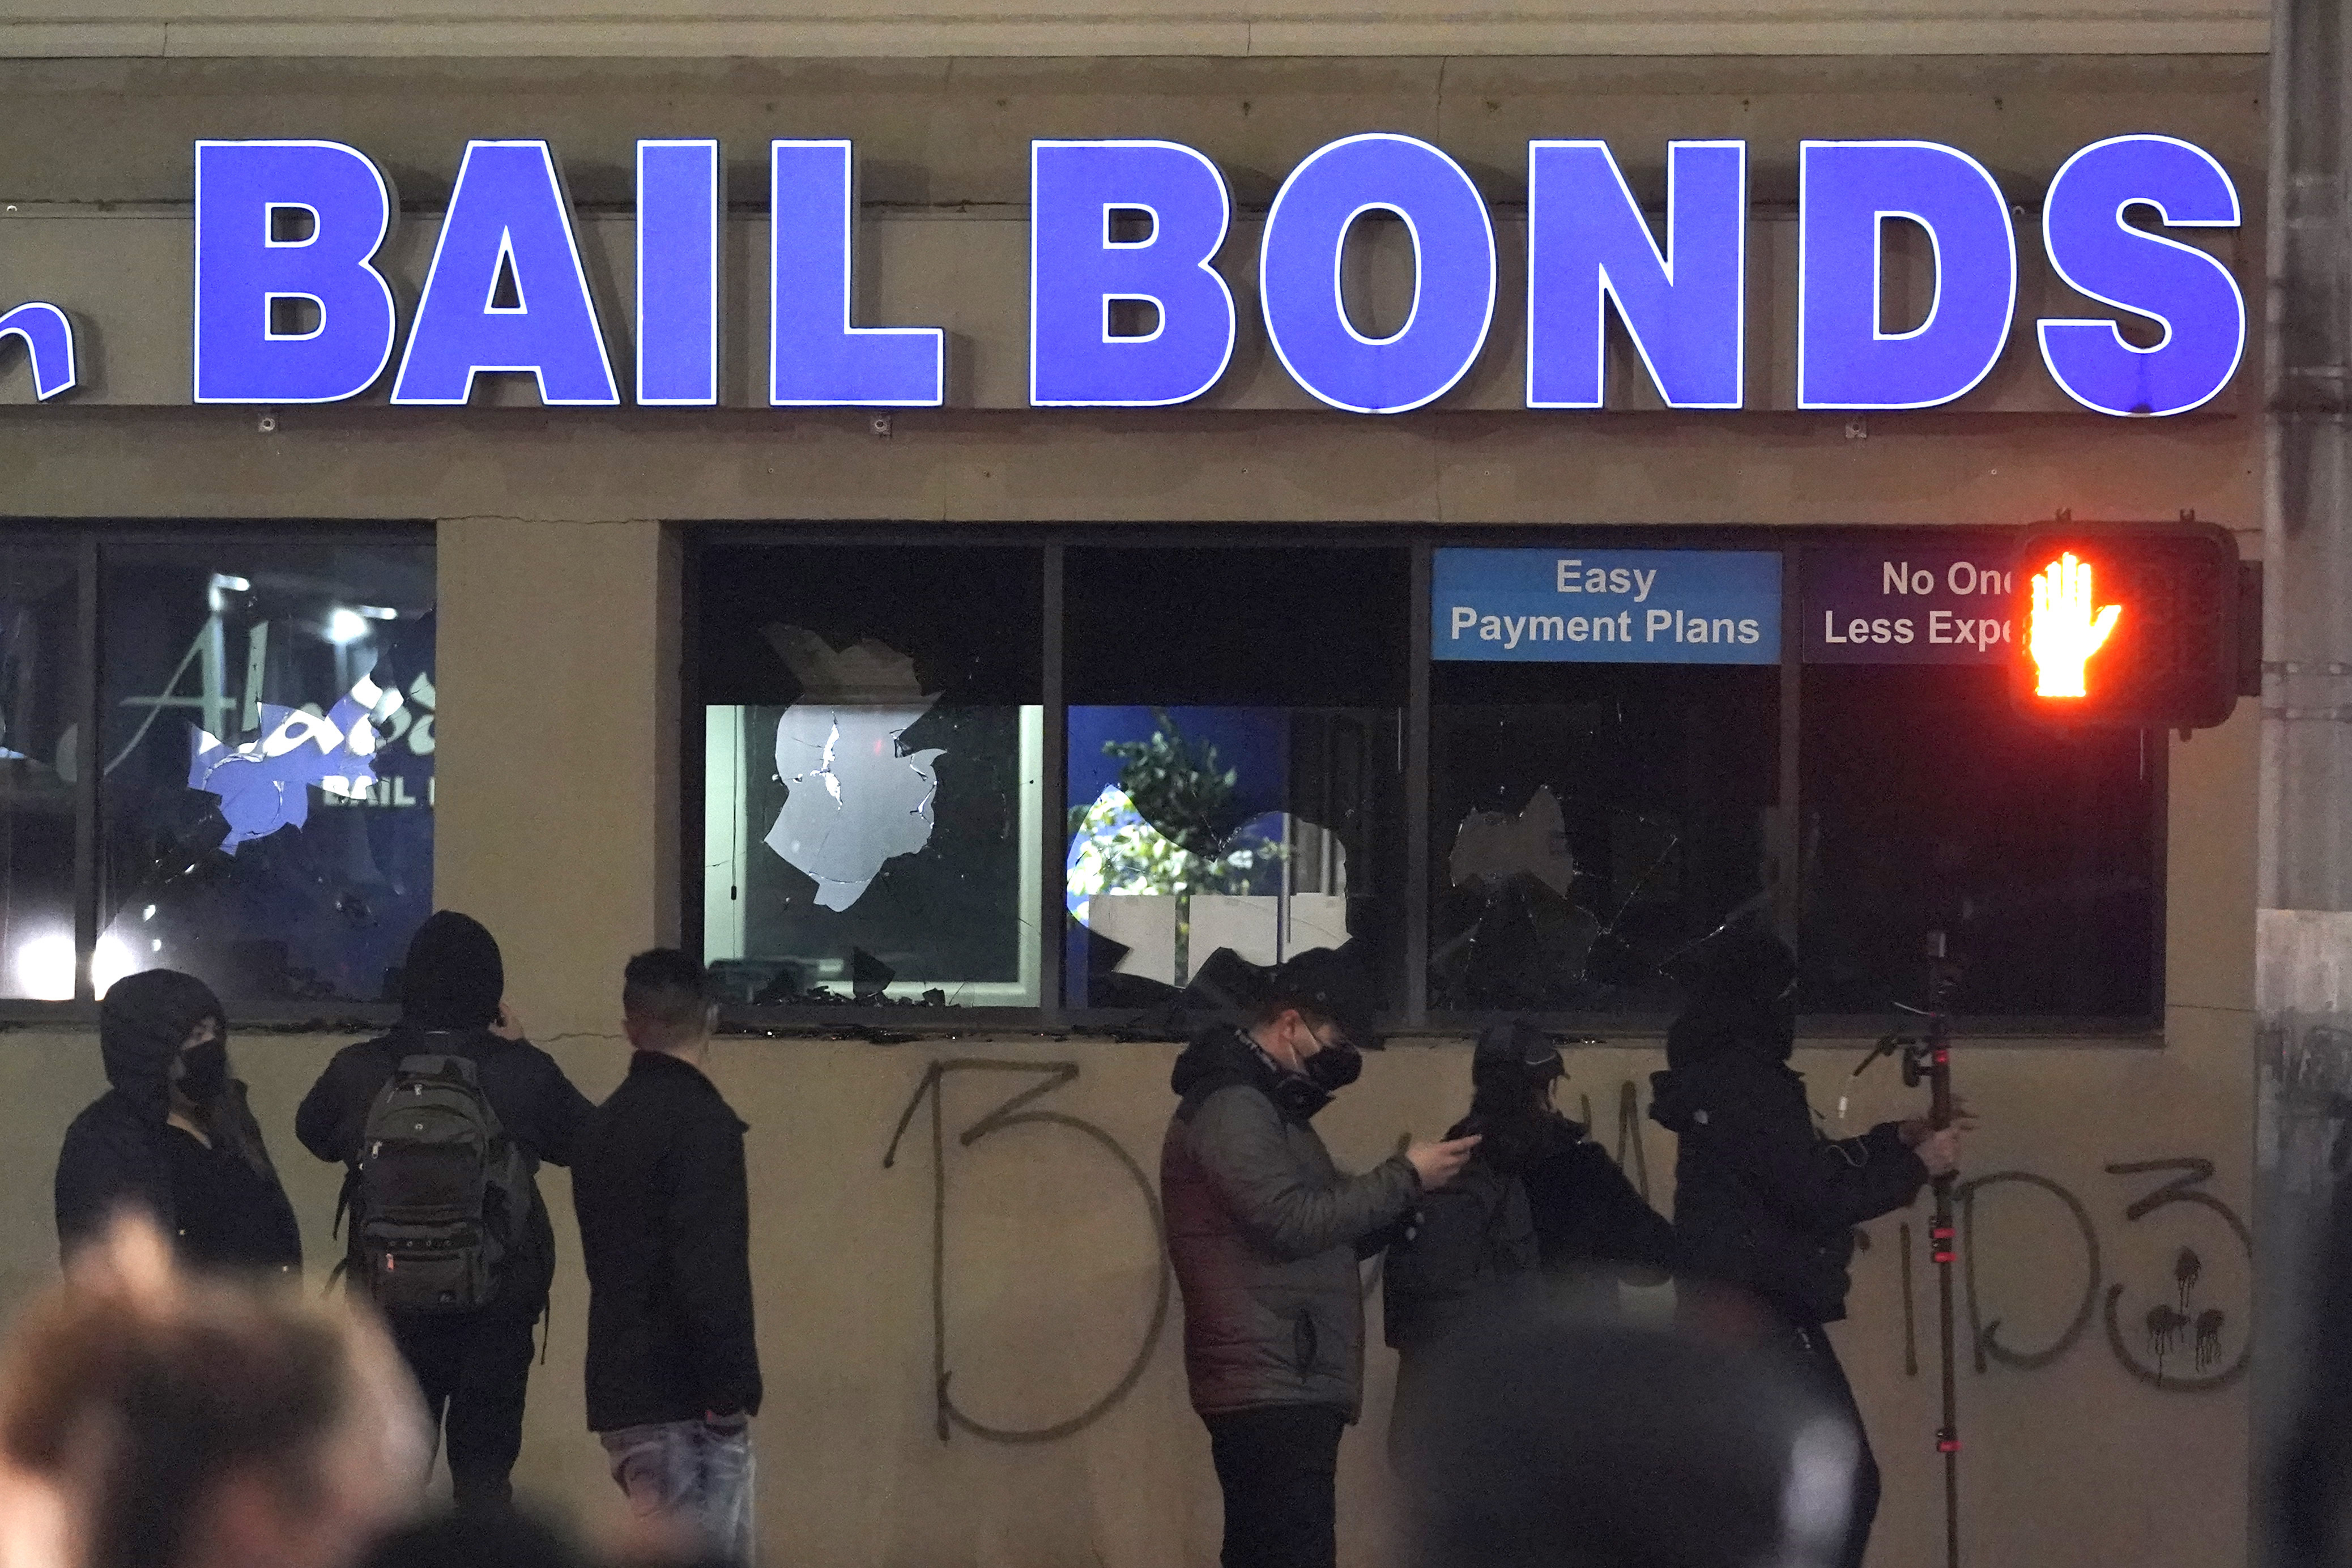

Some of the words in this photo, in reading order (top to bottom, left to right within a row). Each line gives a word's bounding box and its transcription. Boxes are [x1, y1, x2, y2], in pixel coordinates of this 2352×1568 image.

[194, 139, 944, 407] BAIL
[1029, 133, 2246, 416] BONDS
[1557, 560, 1656, 602] Easy
[1883, 561, 1935, 595] No
[1452, 607, 1631, 649] Payment
[1646, 610, 1759, 644] Plans
[1825, 610, 1914, 644] Less
